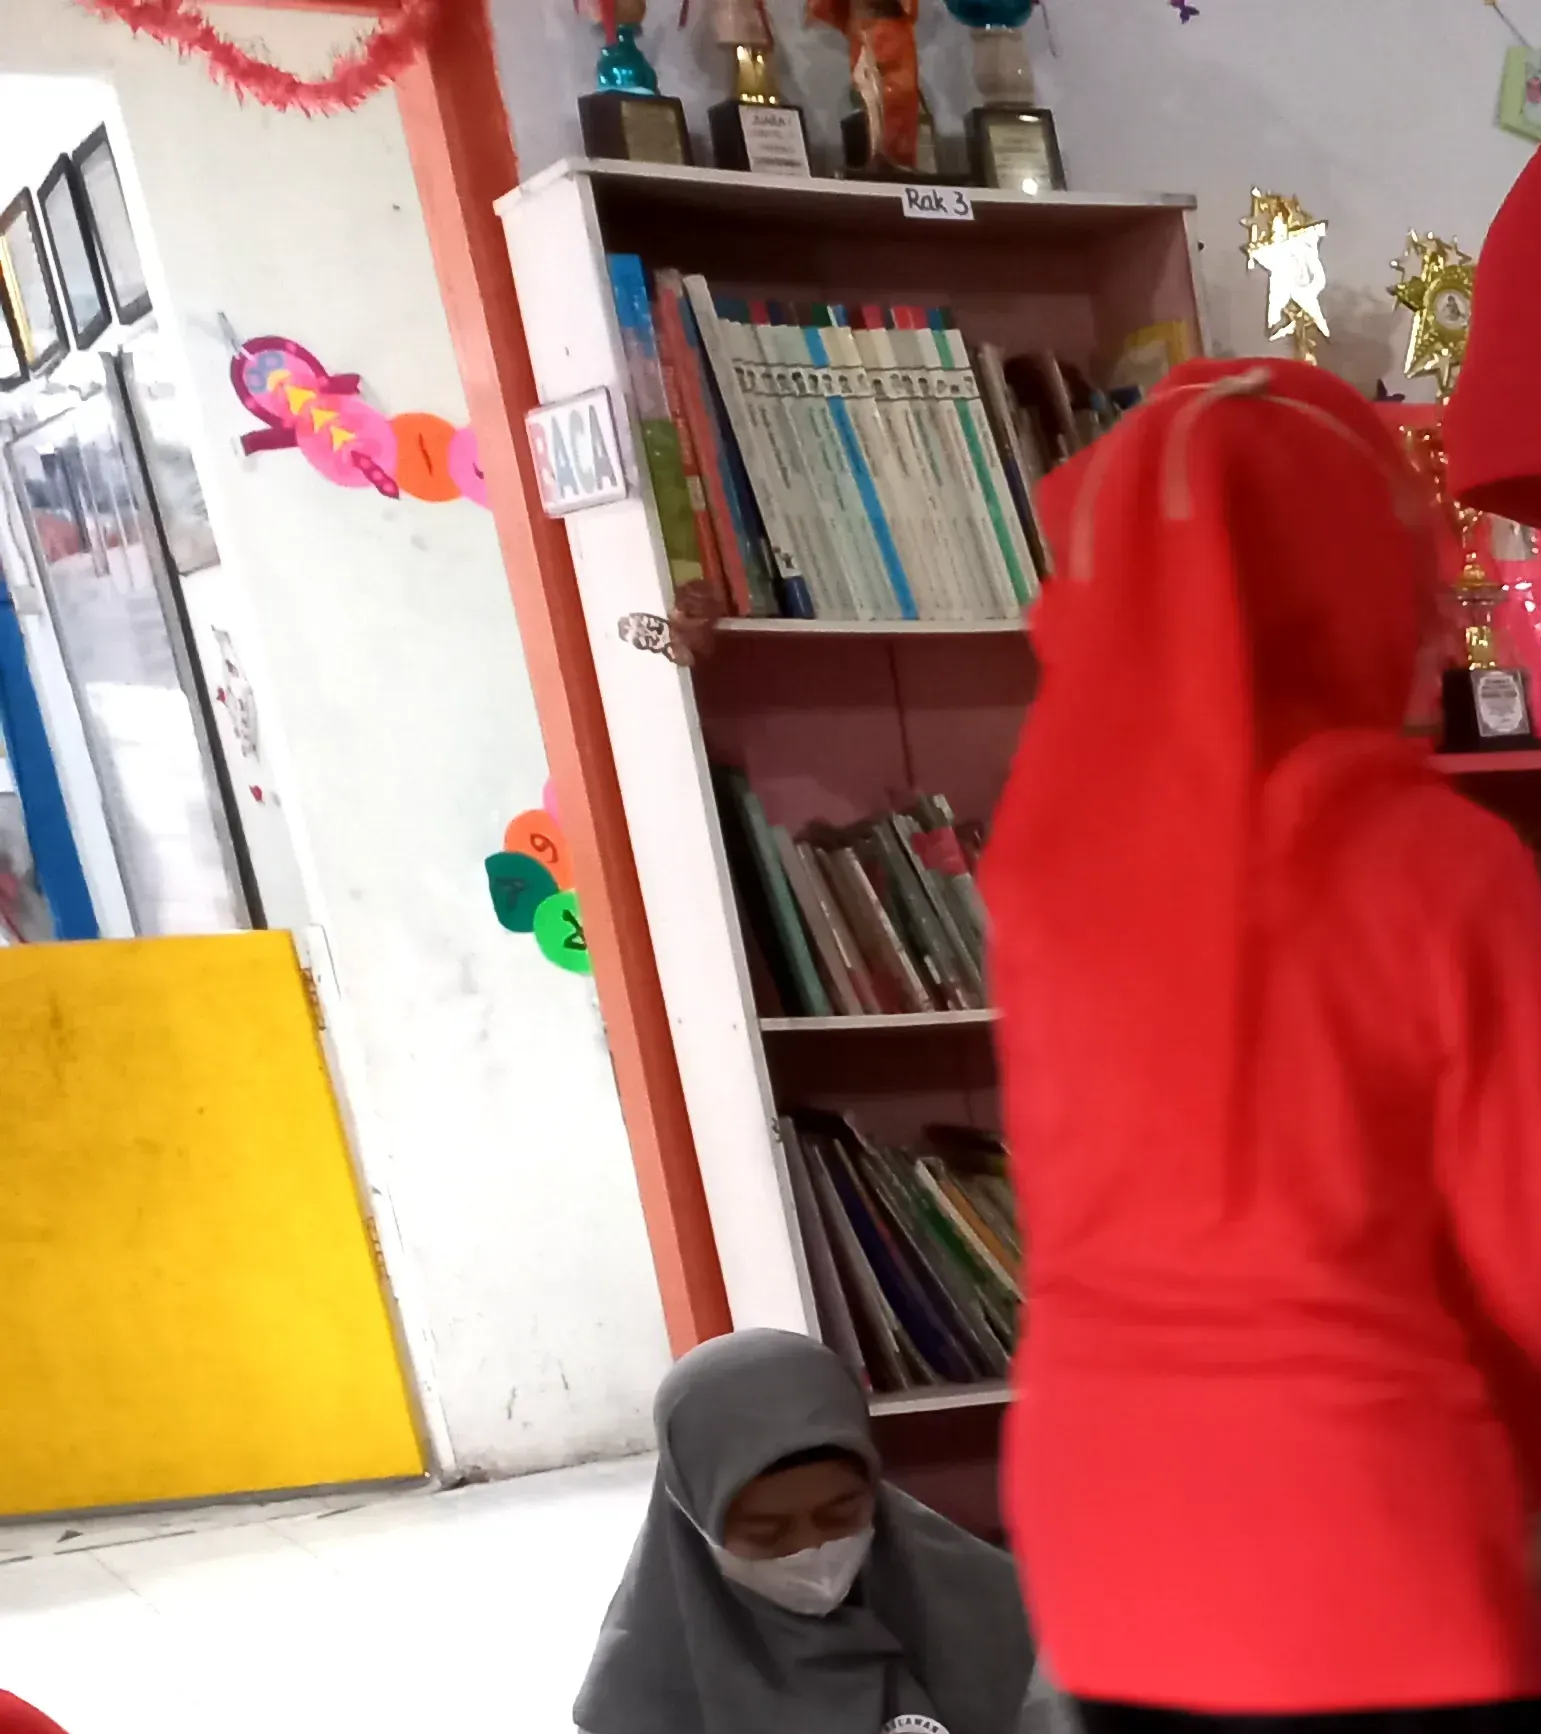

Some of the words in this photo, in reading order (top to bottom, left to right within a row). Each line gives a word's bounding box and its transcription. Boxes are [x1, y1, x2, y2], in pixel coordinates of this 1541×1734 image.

[905, 187, 948, 213] Rak
[953, 190, 969, 215] 3
[528, 404, 618, 502] BACA
